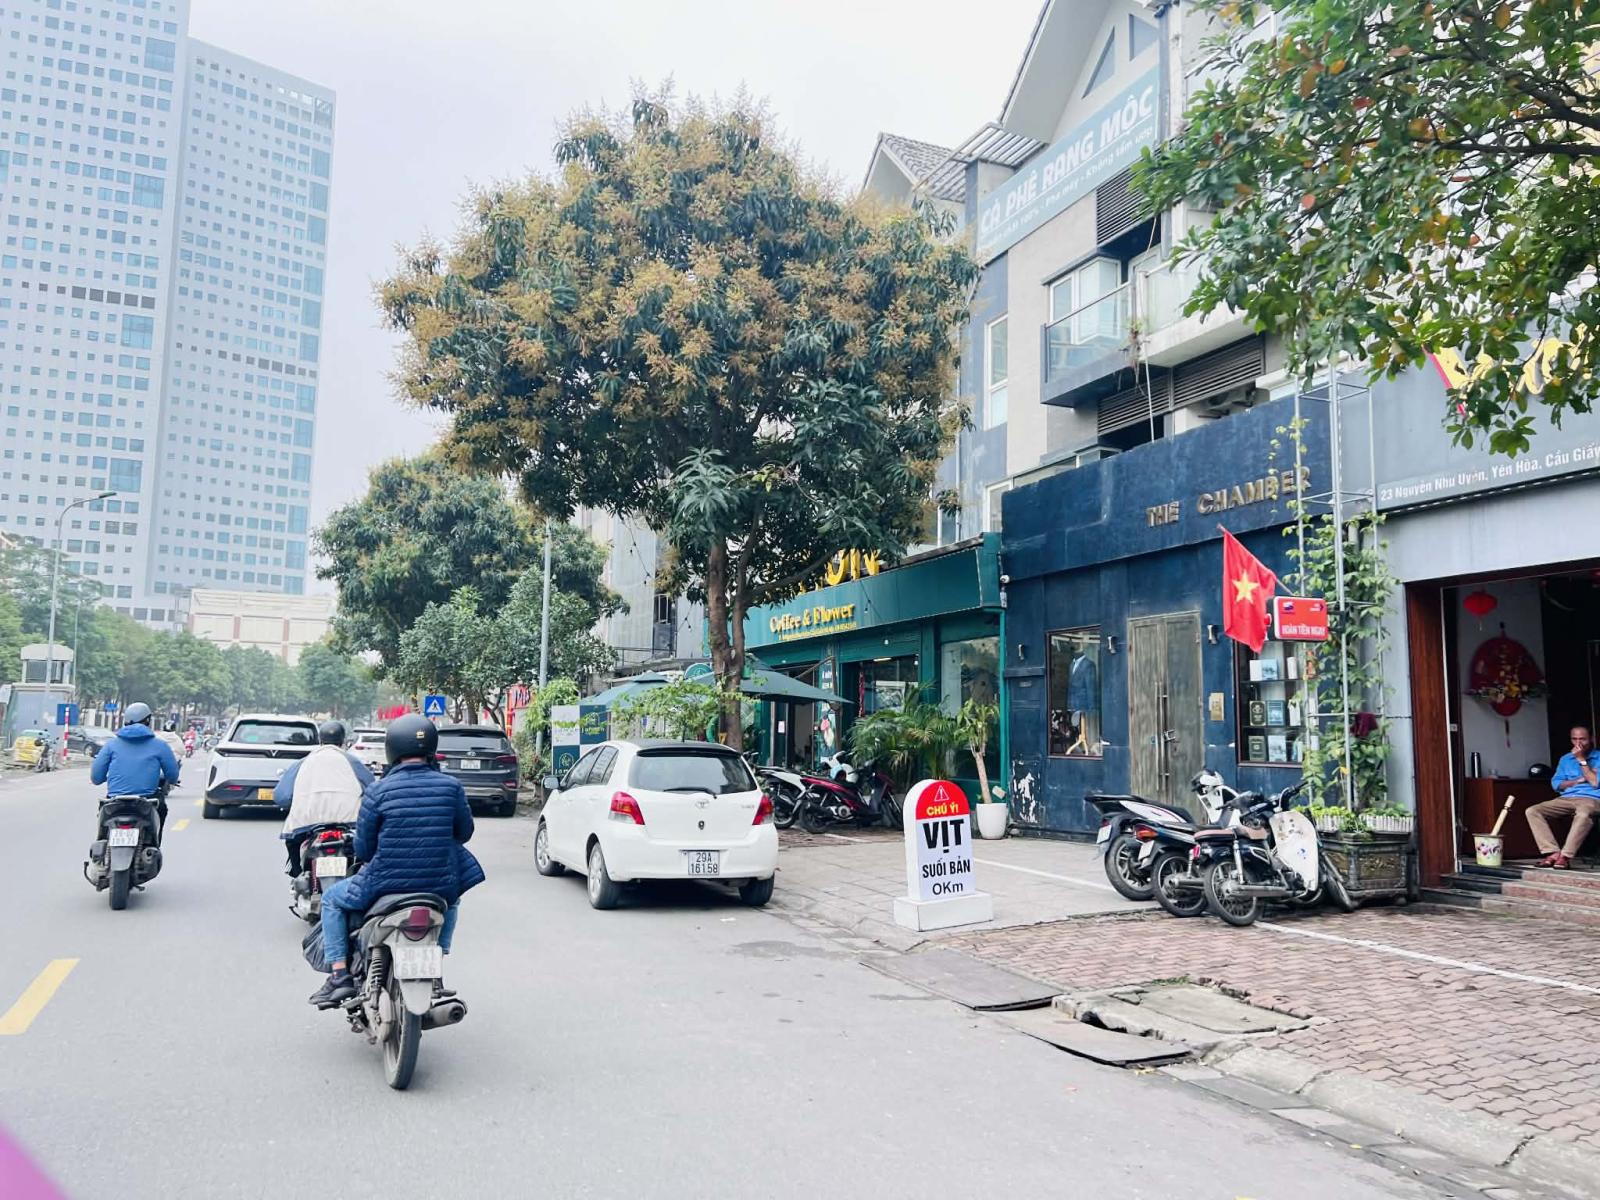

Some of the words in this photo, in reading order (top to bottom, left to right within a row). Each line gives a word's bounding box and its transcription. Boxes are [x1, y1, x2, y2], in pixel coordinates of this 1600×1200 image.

[1042, 130, 1095, 188] RANG
[1146, 501, 1180, 528] THE
[1197, 466, 1312, 515] CHAMBER
[1380, 489, 1393, 501] 23
[770, 612, 801, 632] Coffee
[803, 608, 811, 626] &
[813, 603, 856, 625] Flower
[926, 804, 947, 816] CHÚ
[922, 818, 965, 853] VỊT
[690, 863, 718, 874] 16158
[696, 852, 712, 863] 29A
[922, 857, 946, 879] SUỐI
[950, 856, 971, 875] BẢN
